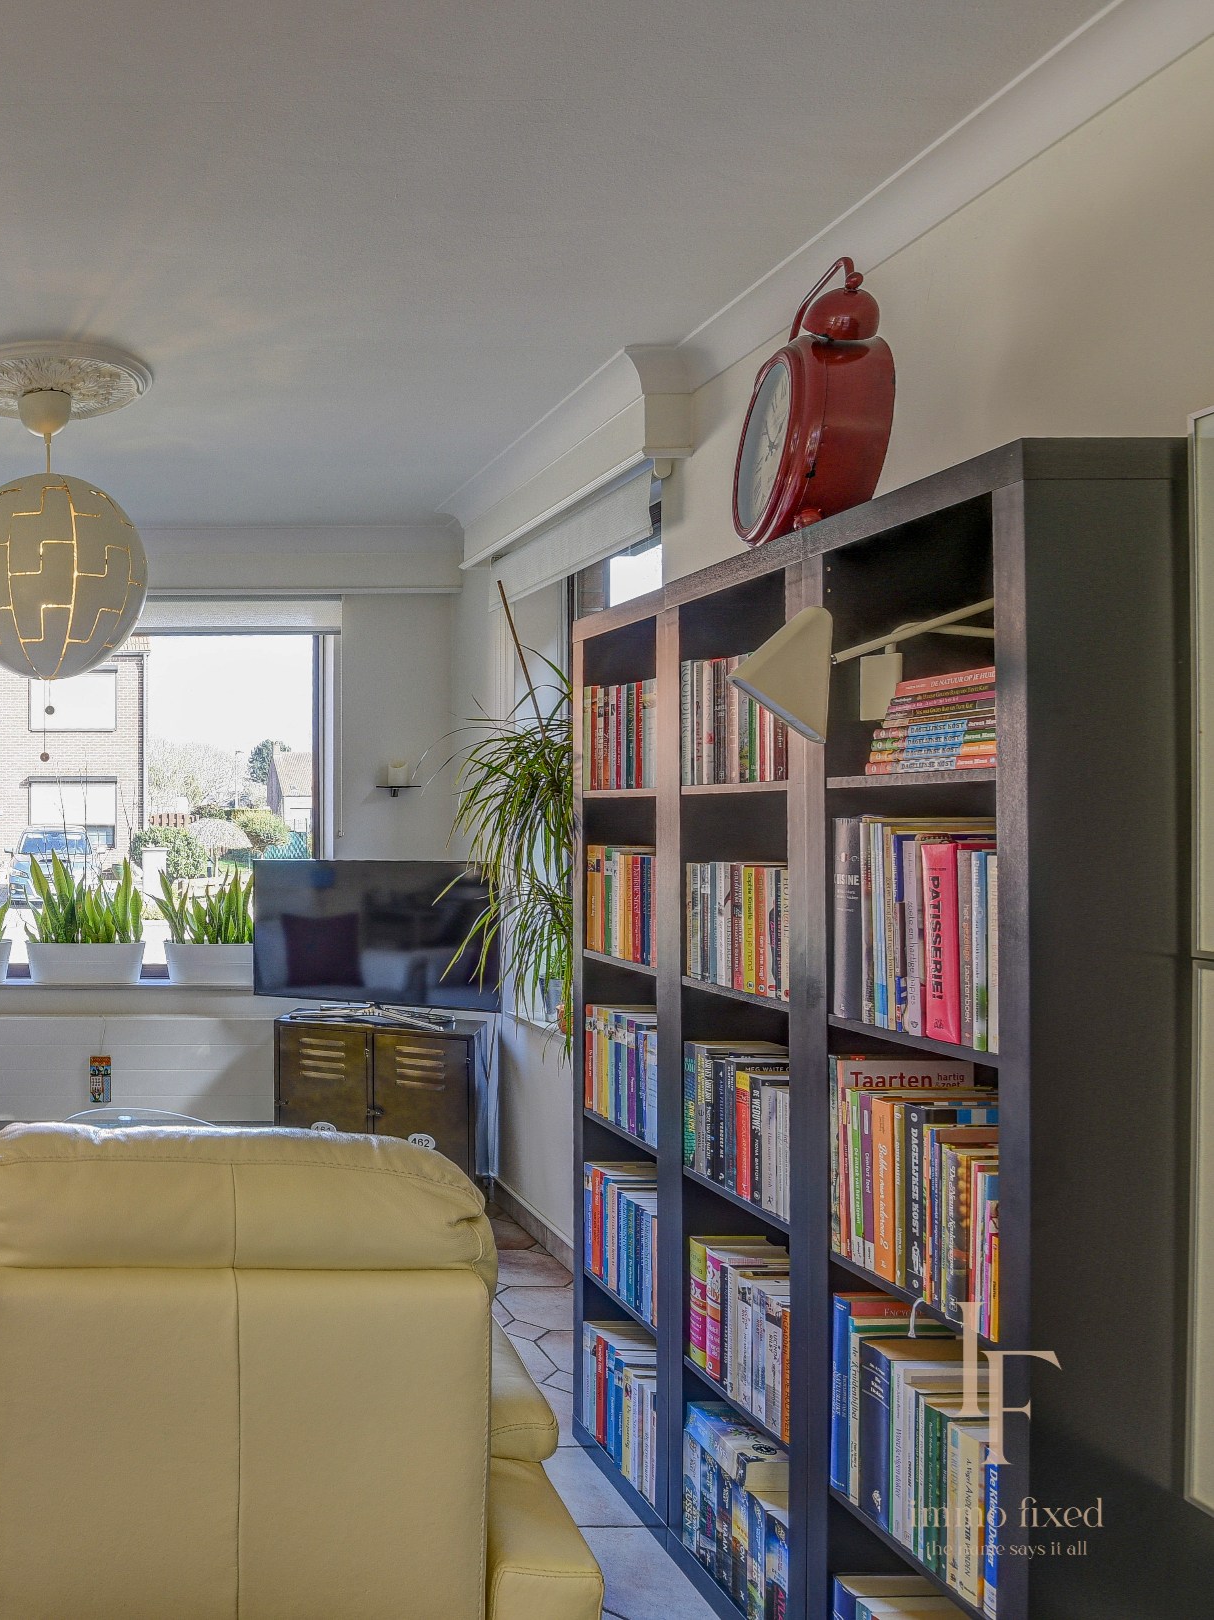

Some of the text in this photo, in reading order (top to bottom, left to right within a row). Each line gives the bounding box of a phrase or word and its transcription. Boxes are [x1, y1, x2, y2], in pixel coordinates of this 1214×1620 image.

[947, 722, 964, 730] KOST
[746, 872, 754, 895] Sophie
[929, 875, 944, 1000] PATISSERIE!
[962, 922, 971, 962] gezellige
[962, 965, 972, 1023] taartenboek
[850, 1071, 965, 1088] Taarten hartig
[752, 1098, 761, 1131] WEDUWE
[411, 1138, 430, 1148] 462
[878, 1143, 888, 1178] Bakken
[950, 1166, 956, 1181] De
[879, 1200, 889, 1237] iedereen
[912, 1202, 920, 1237] KOST
[880, 1238, 889, 1250] 2
[850, 1346, 859, 1421] de Kruidenbijbel
[989, 1468, 998, 1487] De
[778, 1589, 786, 1620] ATLA
